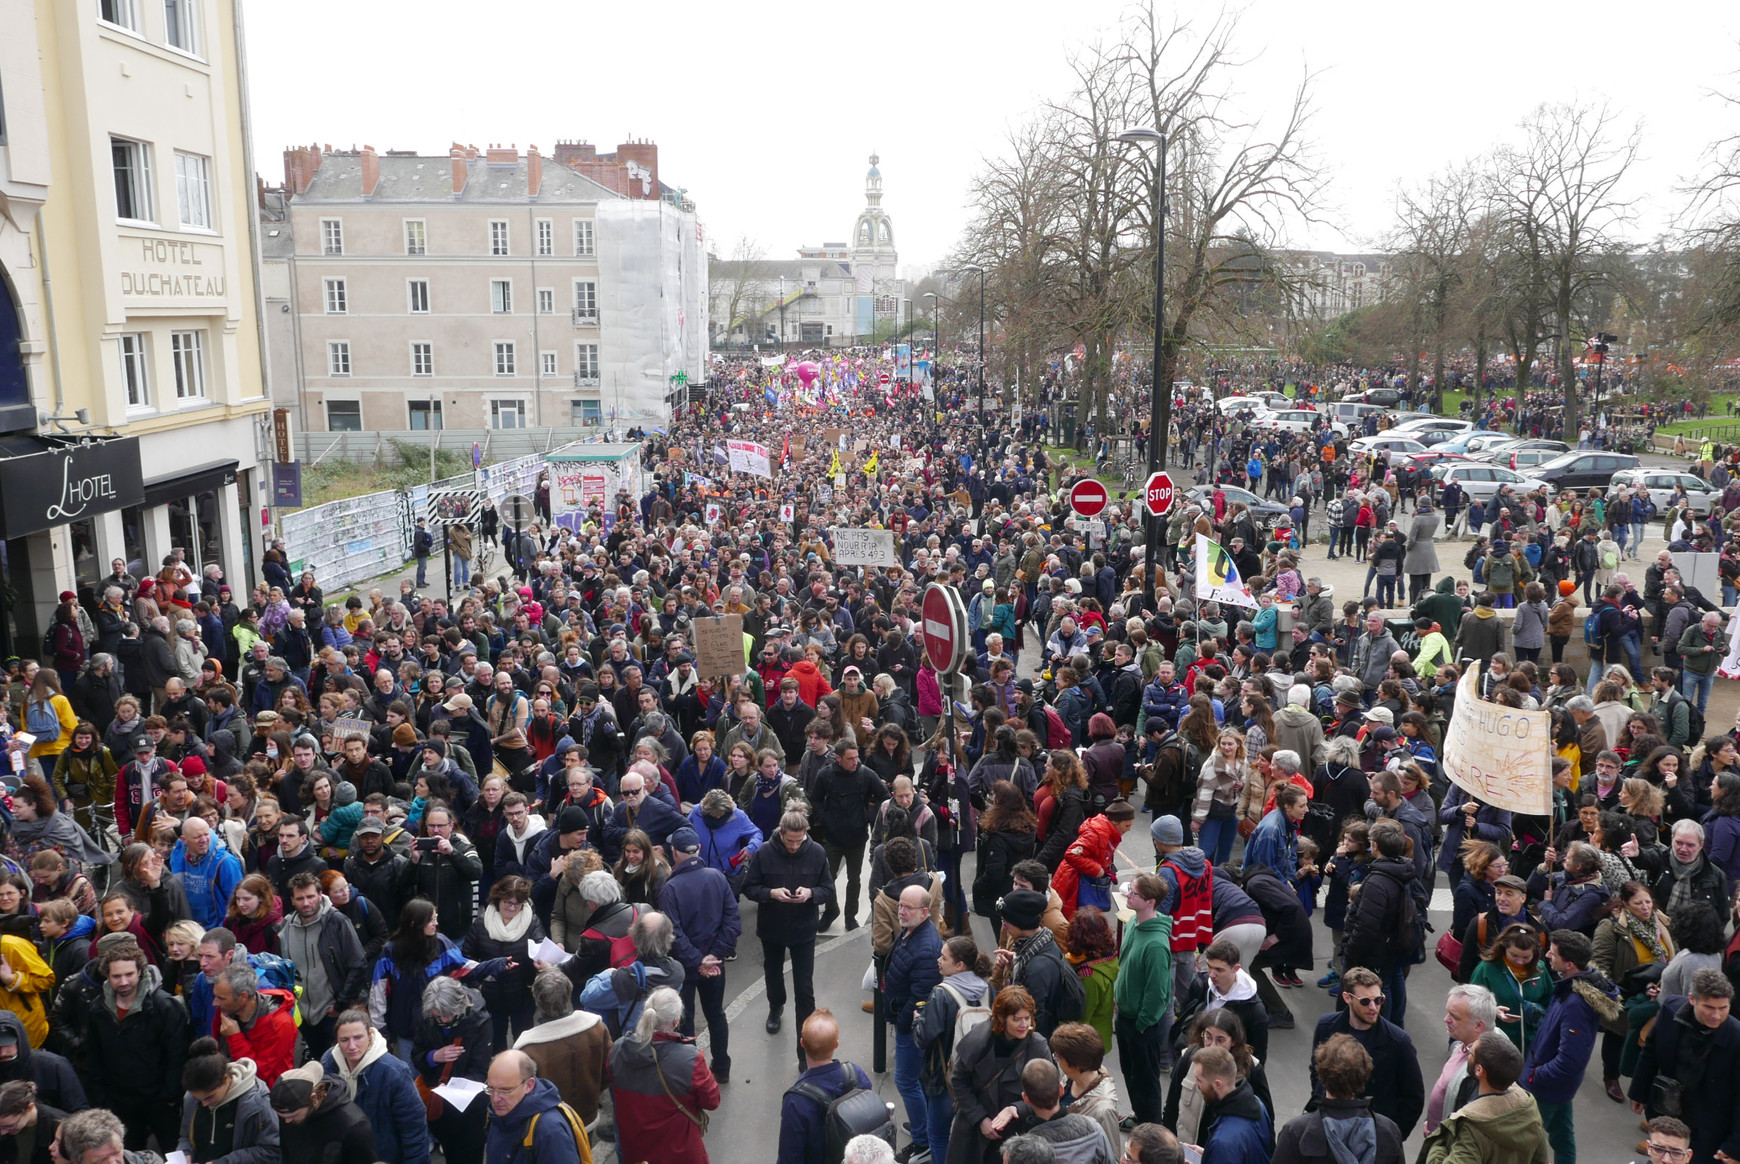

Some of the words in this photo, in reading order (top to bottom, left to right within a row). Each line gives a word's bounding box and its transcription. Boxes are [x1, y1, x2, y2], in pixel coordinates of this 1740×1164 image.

[142, 240, 202, 265] HOTEL
[277, 422, 288, 464] HOTEL
[1149, 487, 1172, 502] STOP
[836, 531, 848, 540] NE
[851, 531, 869, 541] PAS
[837, 541, 877, 551] NOURRIR
[1479, 709, 1530, 739] HUGO
